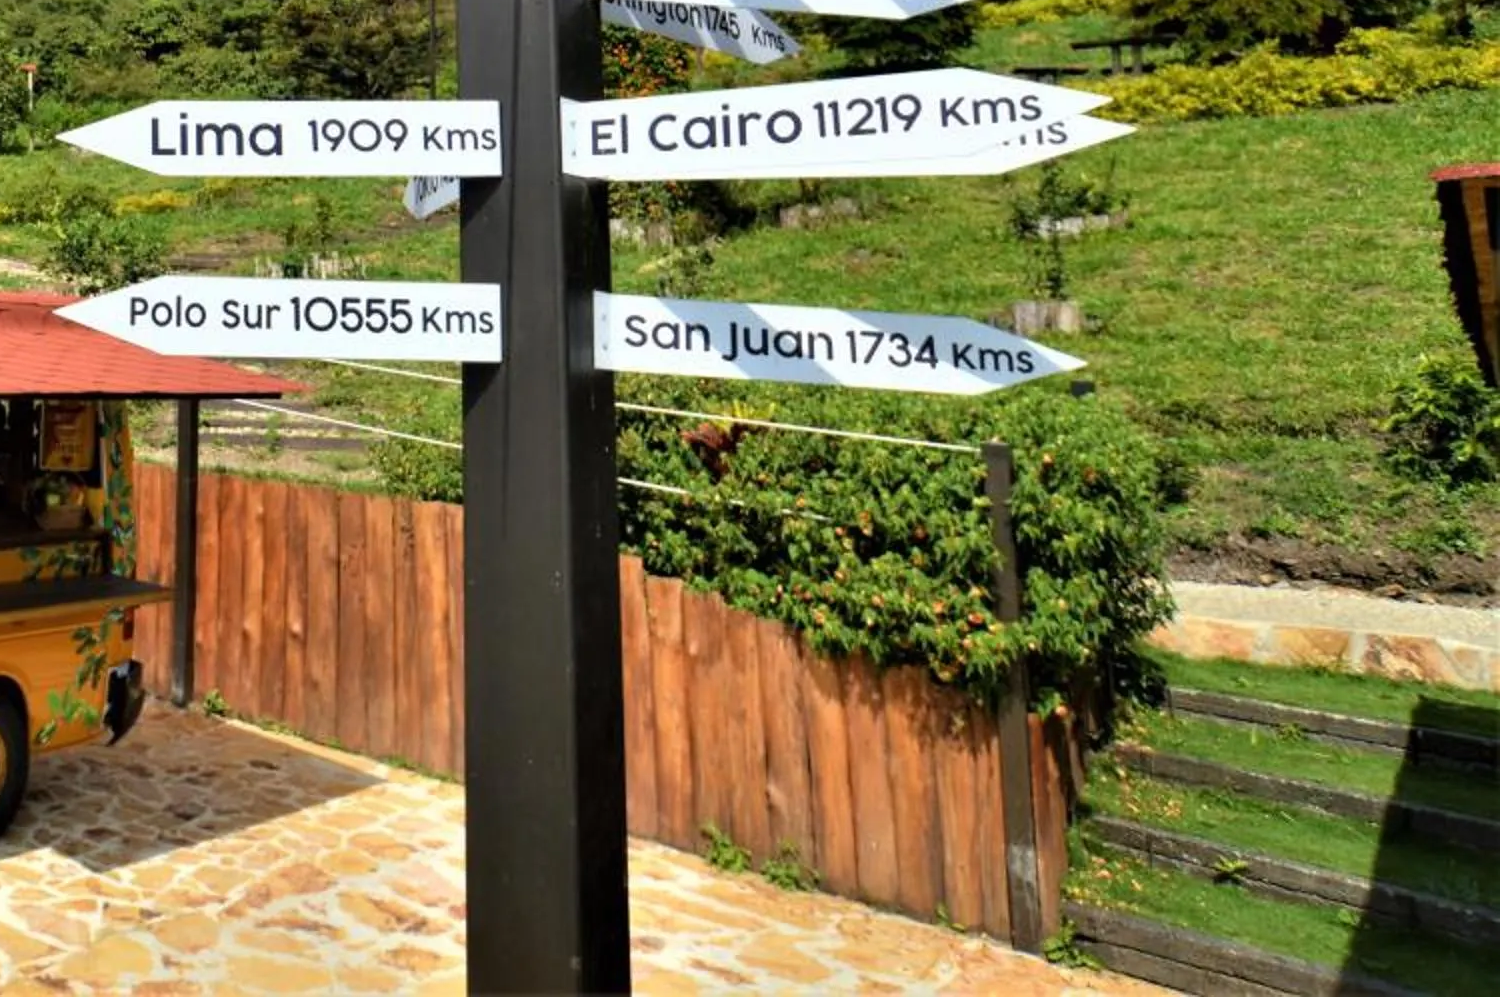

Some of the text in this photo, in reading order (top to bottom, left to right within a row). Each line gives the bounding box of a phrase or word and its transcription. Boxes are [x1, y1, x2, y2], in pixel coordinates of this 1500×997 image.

[704, 4, 741, 39] 1745
[751, 26, 786, 51] Kms
[151, 112, 497, 156] Lima 1909 Kms
[590, 93, 1042, 155] El Cairo 11219 Kms
[129, 296, 494, 335] Polo Sur 10555 Kms
[624, 315, 1034, 373] San Juan 1734 Kms
